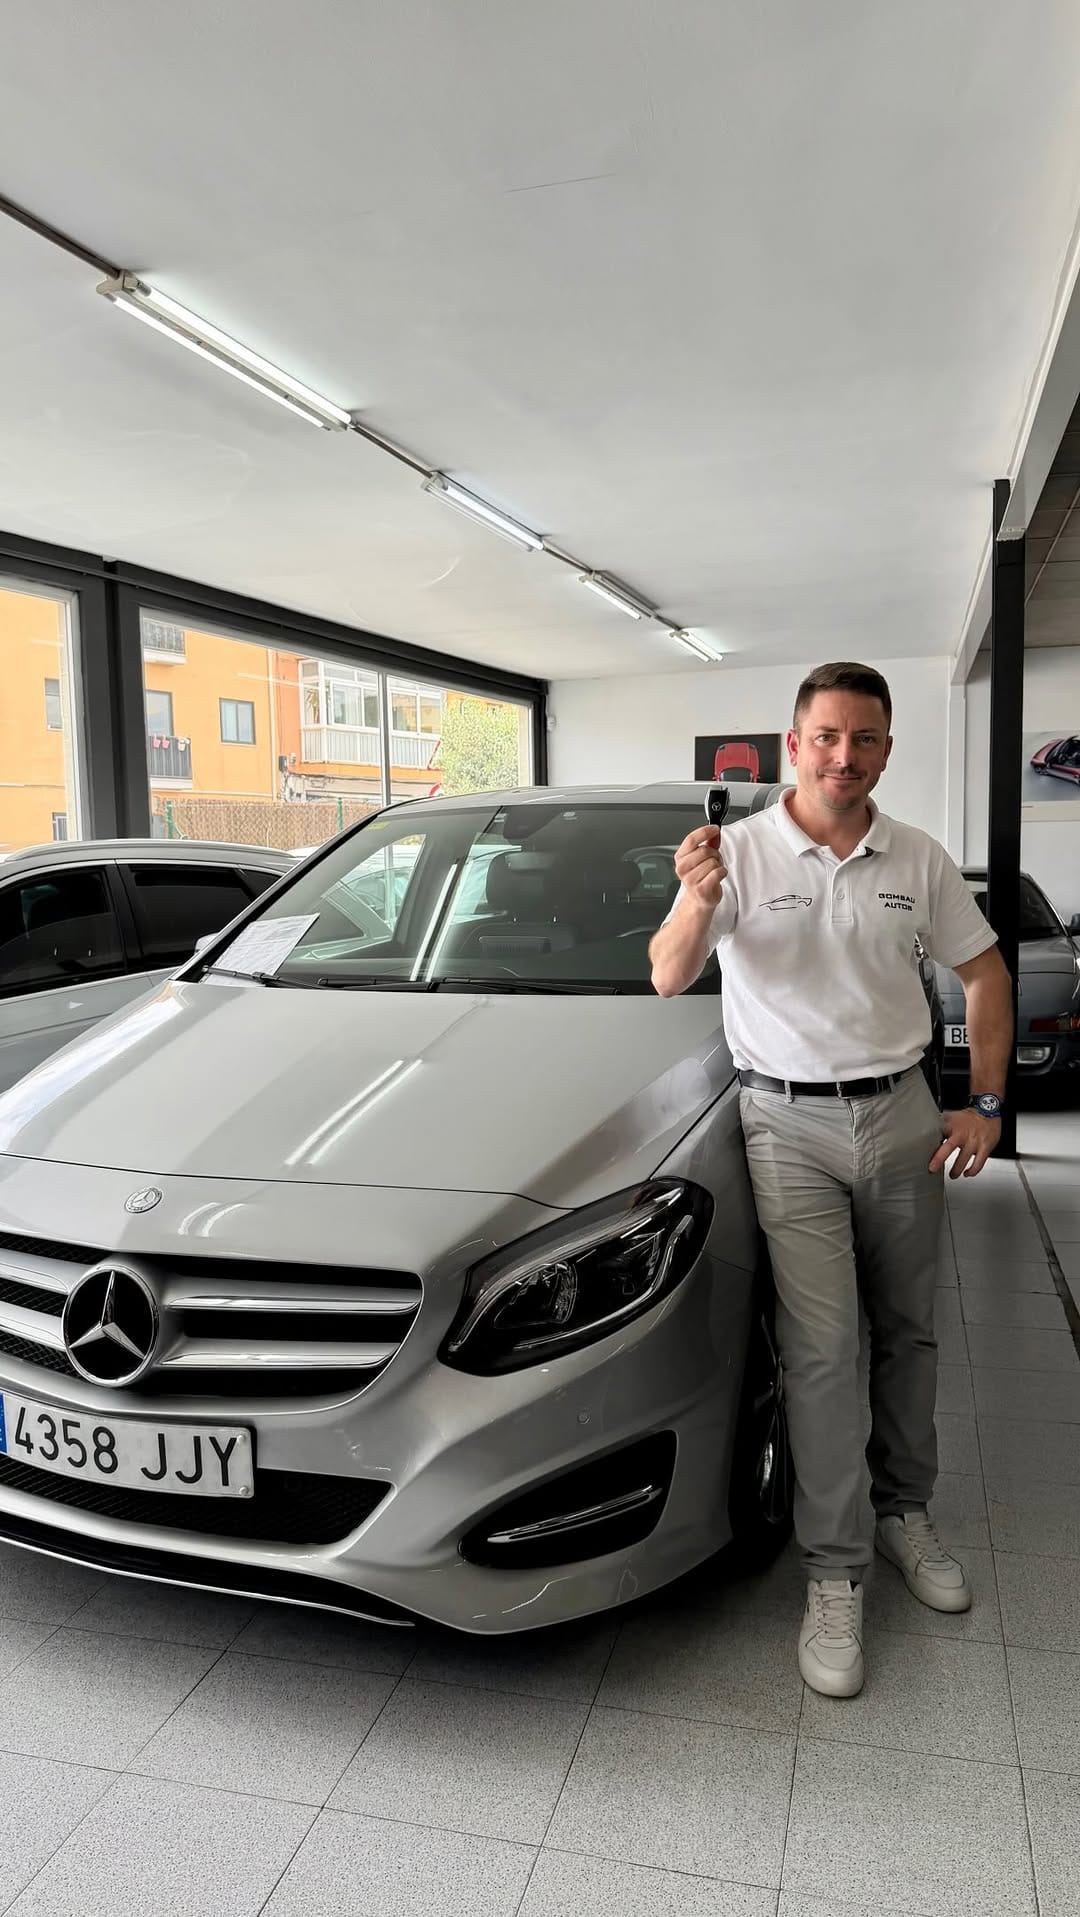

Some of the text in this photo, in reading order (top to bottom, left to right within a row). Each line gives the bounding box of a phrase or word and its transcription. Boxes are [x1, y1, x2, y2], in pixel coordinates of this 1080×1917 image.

[884, 901, 913, 912] AUTOS
[14, 1406, 237, 1487] 4358 JJY
